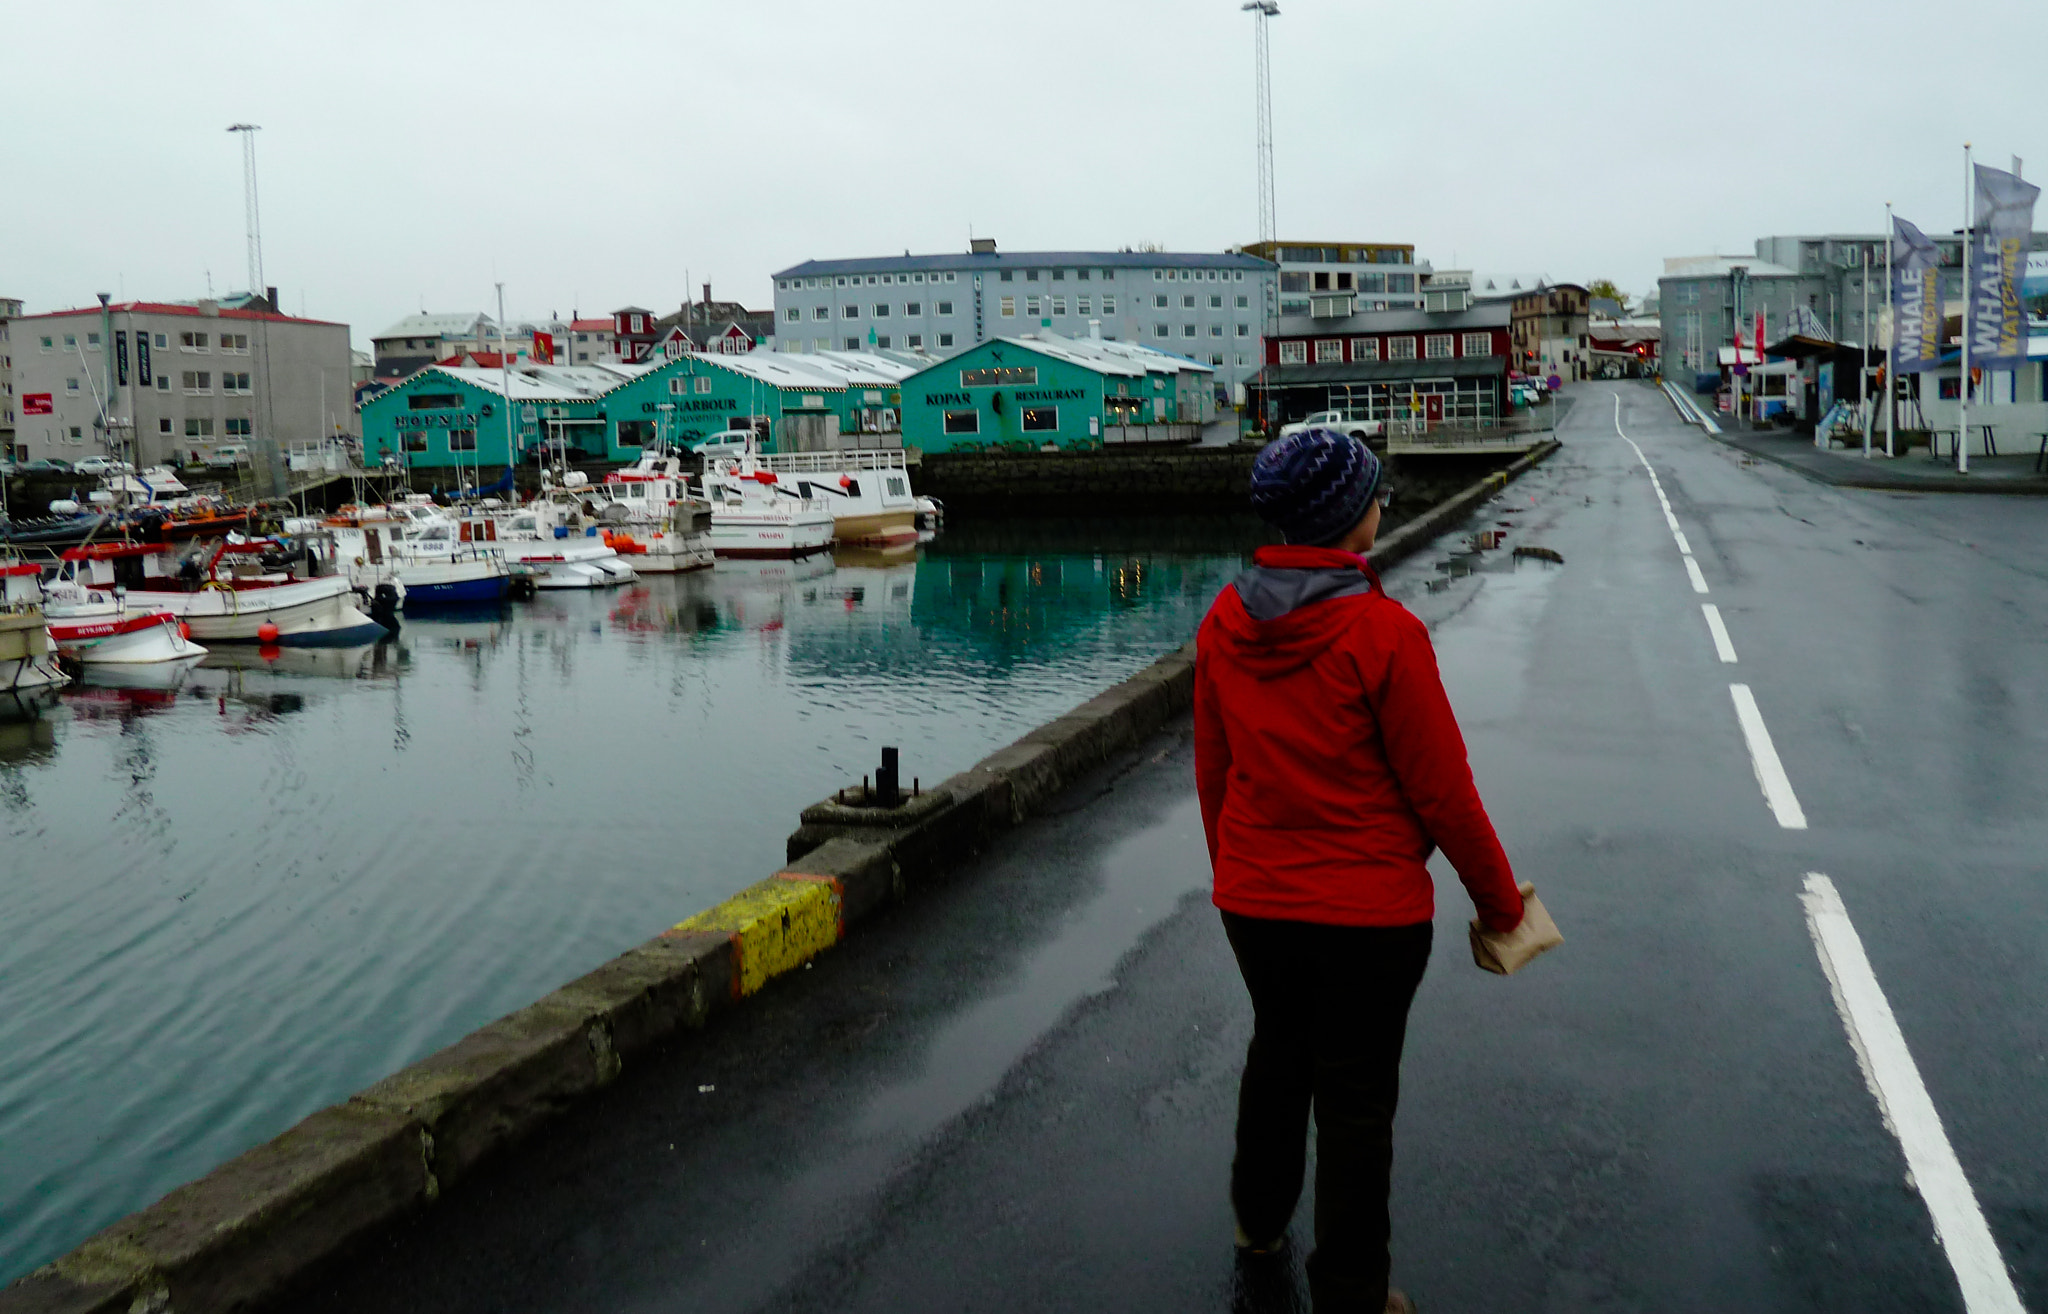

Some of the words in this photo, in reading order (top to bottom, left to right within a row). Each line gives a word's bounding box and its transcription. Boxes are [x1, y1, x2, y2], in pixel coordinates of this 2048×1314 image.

[1899, 268, 1922, 363] WHALE
[1920, 267, 1937, 360] WATCHING
[1971, 233, 2002, 354] WHALE
[1998, 238, 2020, 356] WATCHING
[926, 392, 971, 406] KOPAR
[1015, 389, 1086, 401] RESTAURANT
